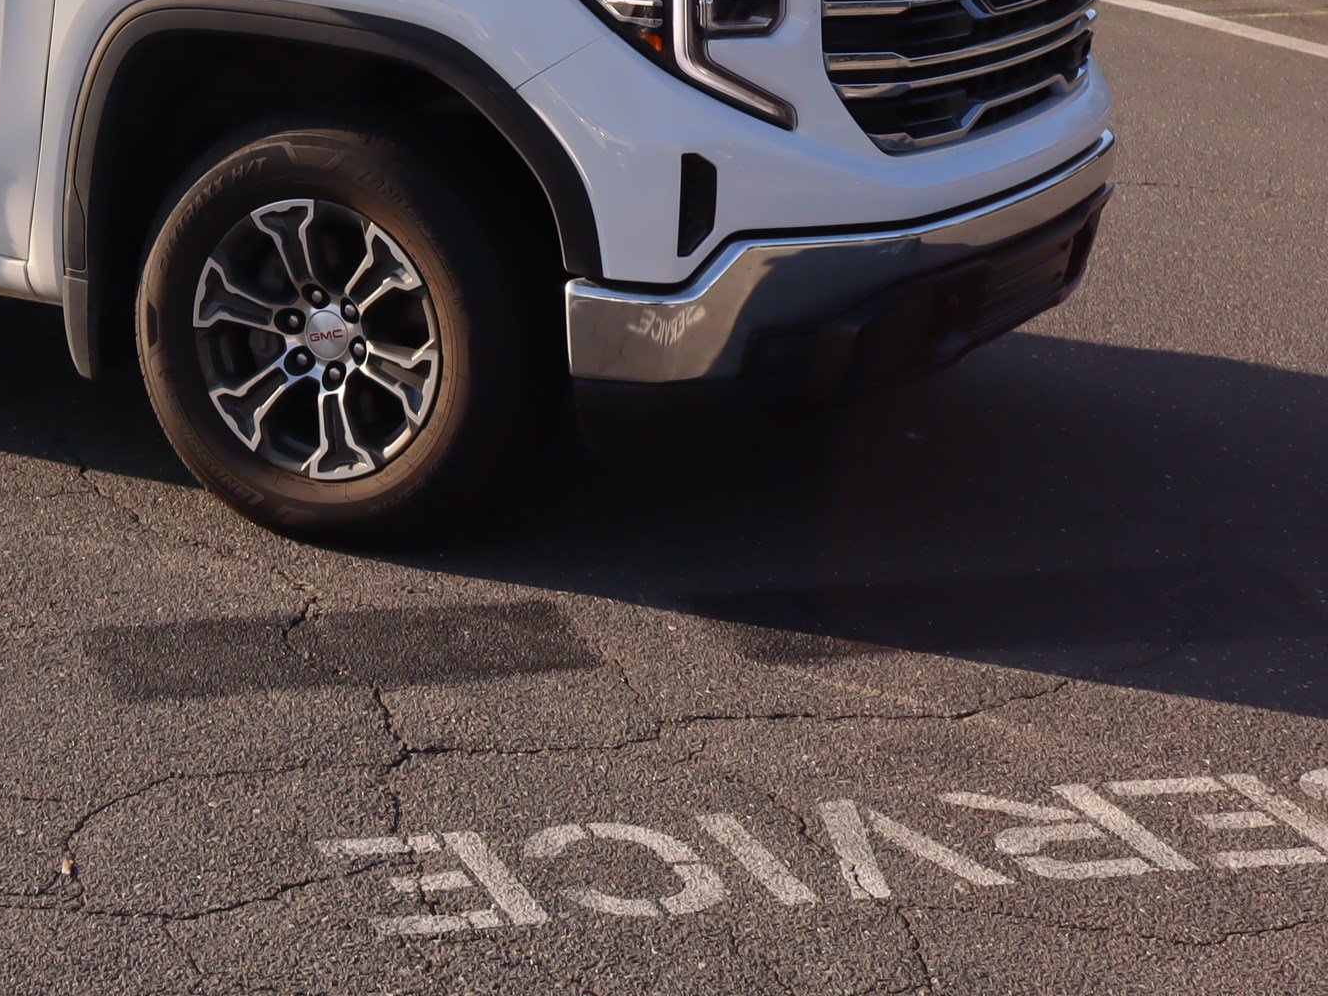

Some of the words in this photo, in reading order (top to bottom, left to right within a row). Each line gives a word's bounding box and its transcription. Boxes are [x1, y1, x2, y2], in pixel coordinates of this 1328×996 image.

[232, 157, 267, 181] H/T
[309, 328, 344, 342] GMC
[314, 769, 1328, 937] ERVICE
